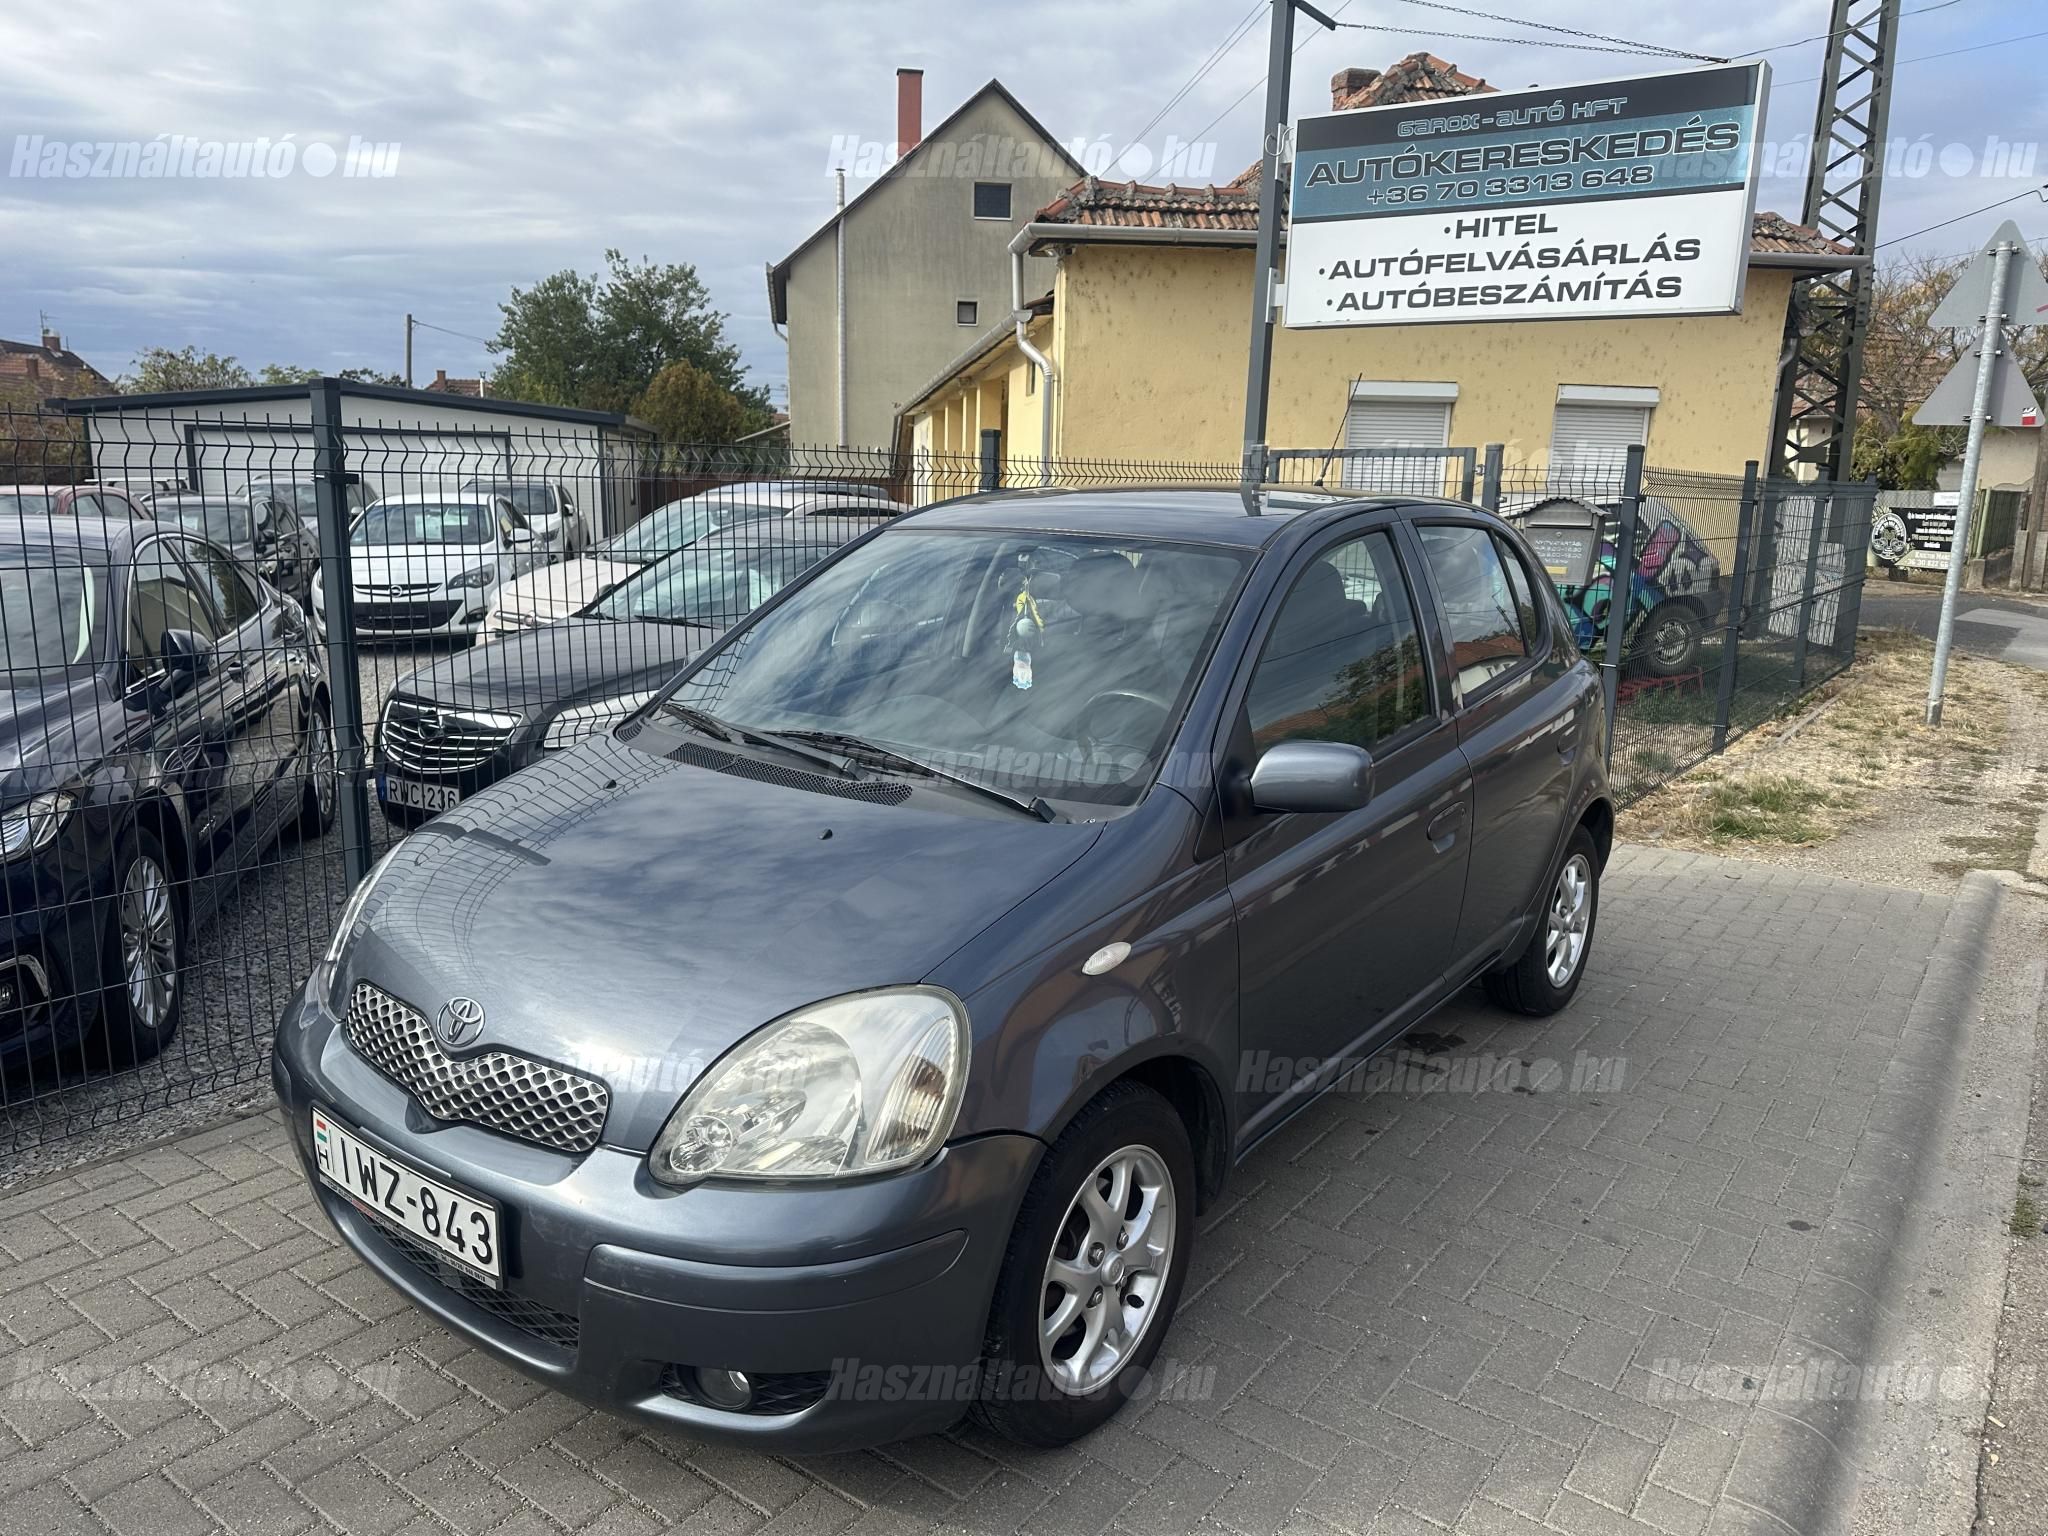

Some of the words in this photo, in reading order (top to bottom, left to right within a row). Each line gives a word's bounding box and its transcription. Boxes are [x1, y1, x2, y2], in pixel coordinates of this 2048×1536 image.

[1305, 115, 1740, 188] AUTÓKERESKEDÉS
[1366, 184, 1428, 206] +36
[1437, 181, 1479, 200] 70
[1485, 173, 1573, 198] 3313
[1581, 165, 1654, 188] 648
[1455, 213, 1559, 239] HITEL
[1328, 232, 1701, 280] AUTÓFELVÁSÁRLÁS
[1336, 269, 1682, 312] AUTÓBESZÁMÍTÁS
[341, 1137, 492, 1265] IWZ-843
